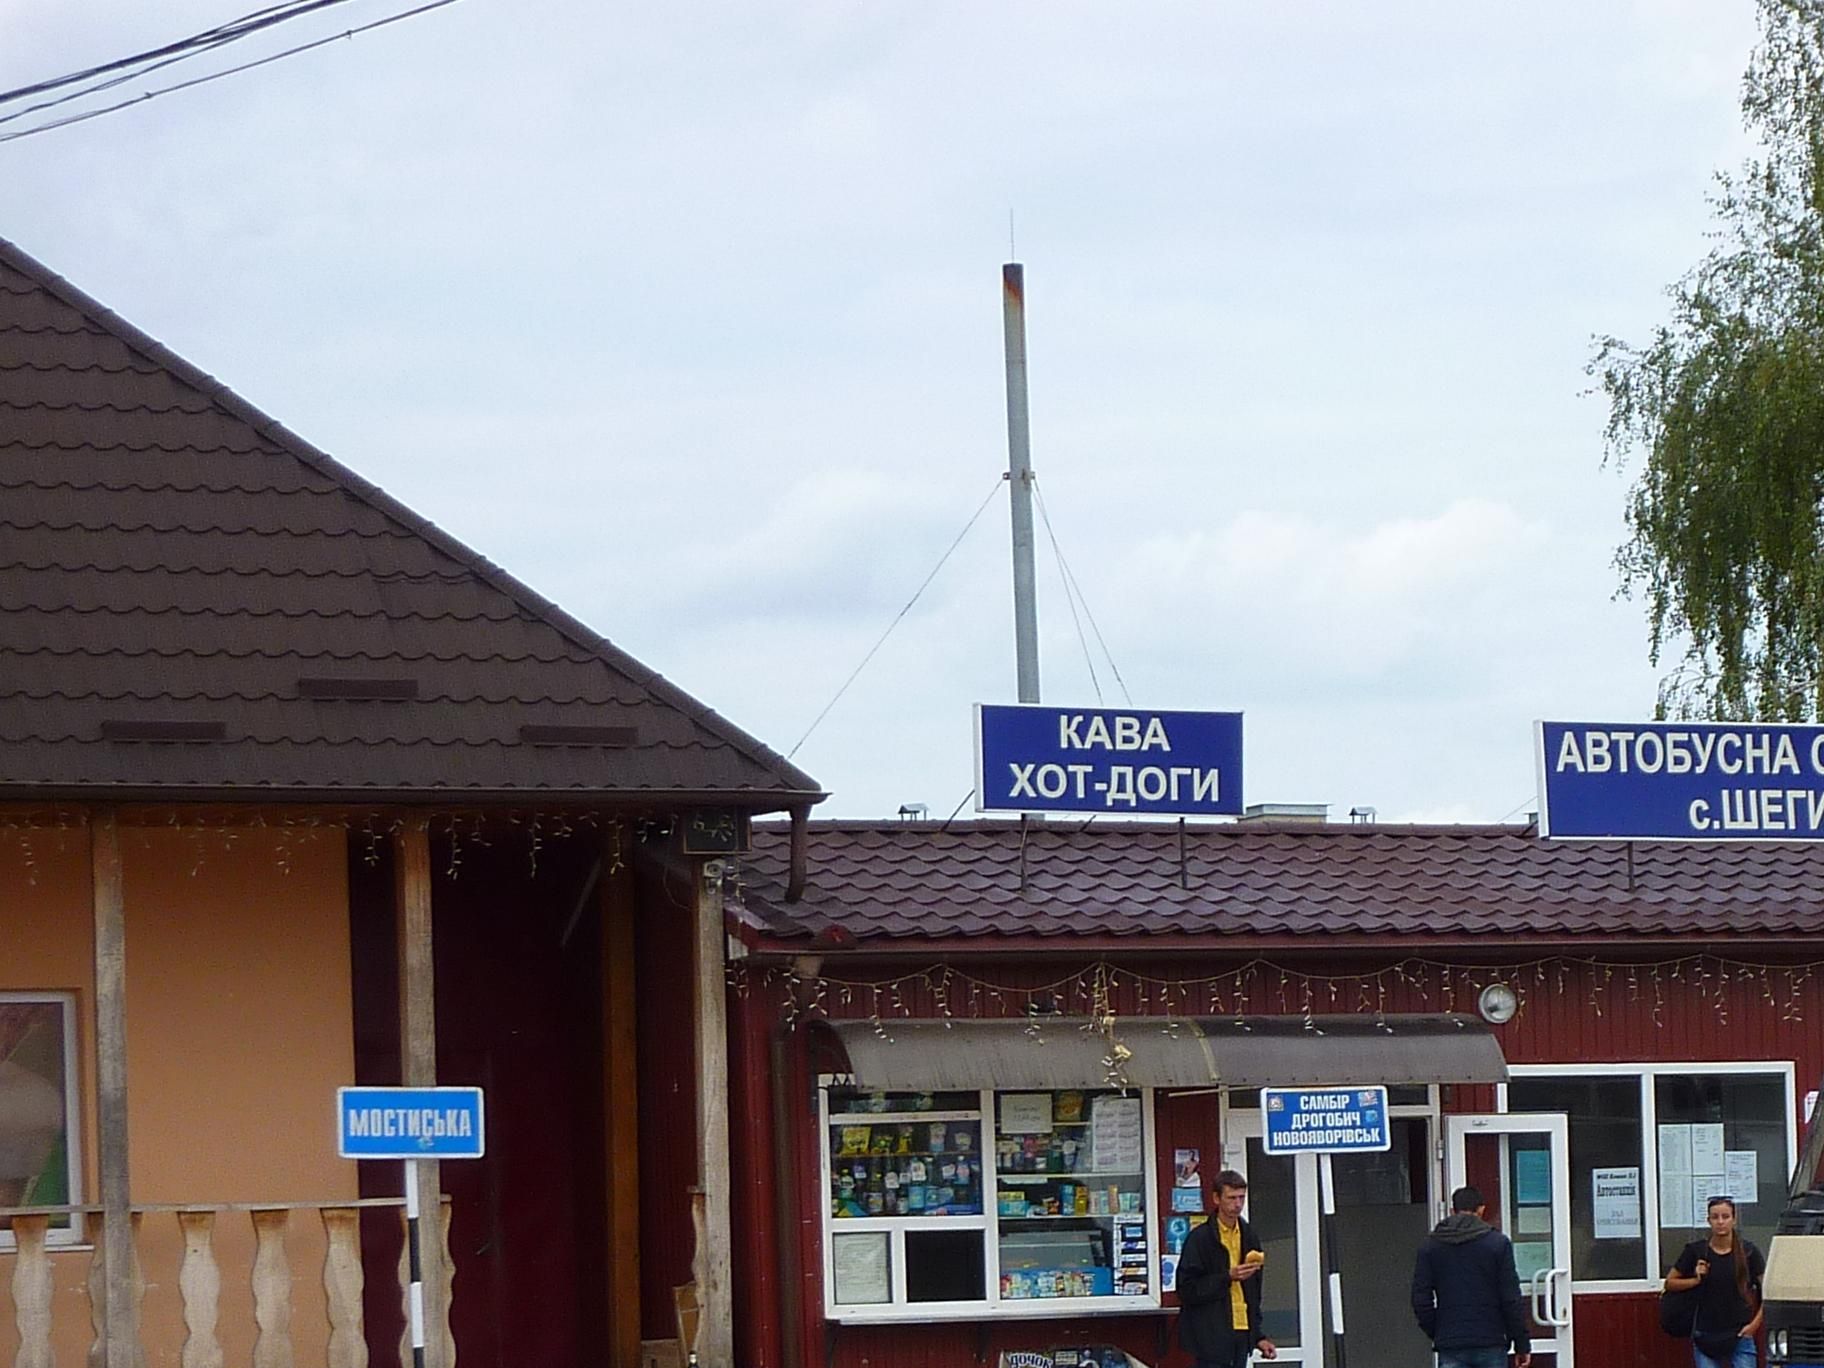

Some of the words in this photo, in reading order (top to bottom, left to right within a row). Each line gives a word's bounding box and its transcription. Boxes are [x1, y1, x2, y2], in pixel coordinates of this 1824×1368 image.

[1060, 714, 1172, 752] КАВА
[1556, 731, 1800, 775] АВТОБУСНА
[1008, 763, 1220, 807] ХОТ-ДОГИ
[1299, 1094, 1350, 1110] САМБІР
[349, 1108, 472, 1137] МОСТИСЬКА
[1291, 1110, 1361, 1130] ДРОГОБИЧ
[1273, 1127, 1381, 1146] НОВОЯВОРІВСЬК
